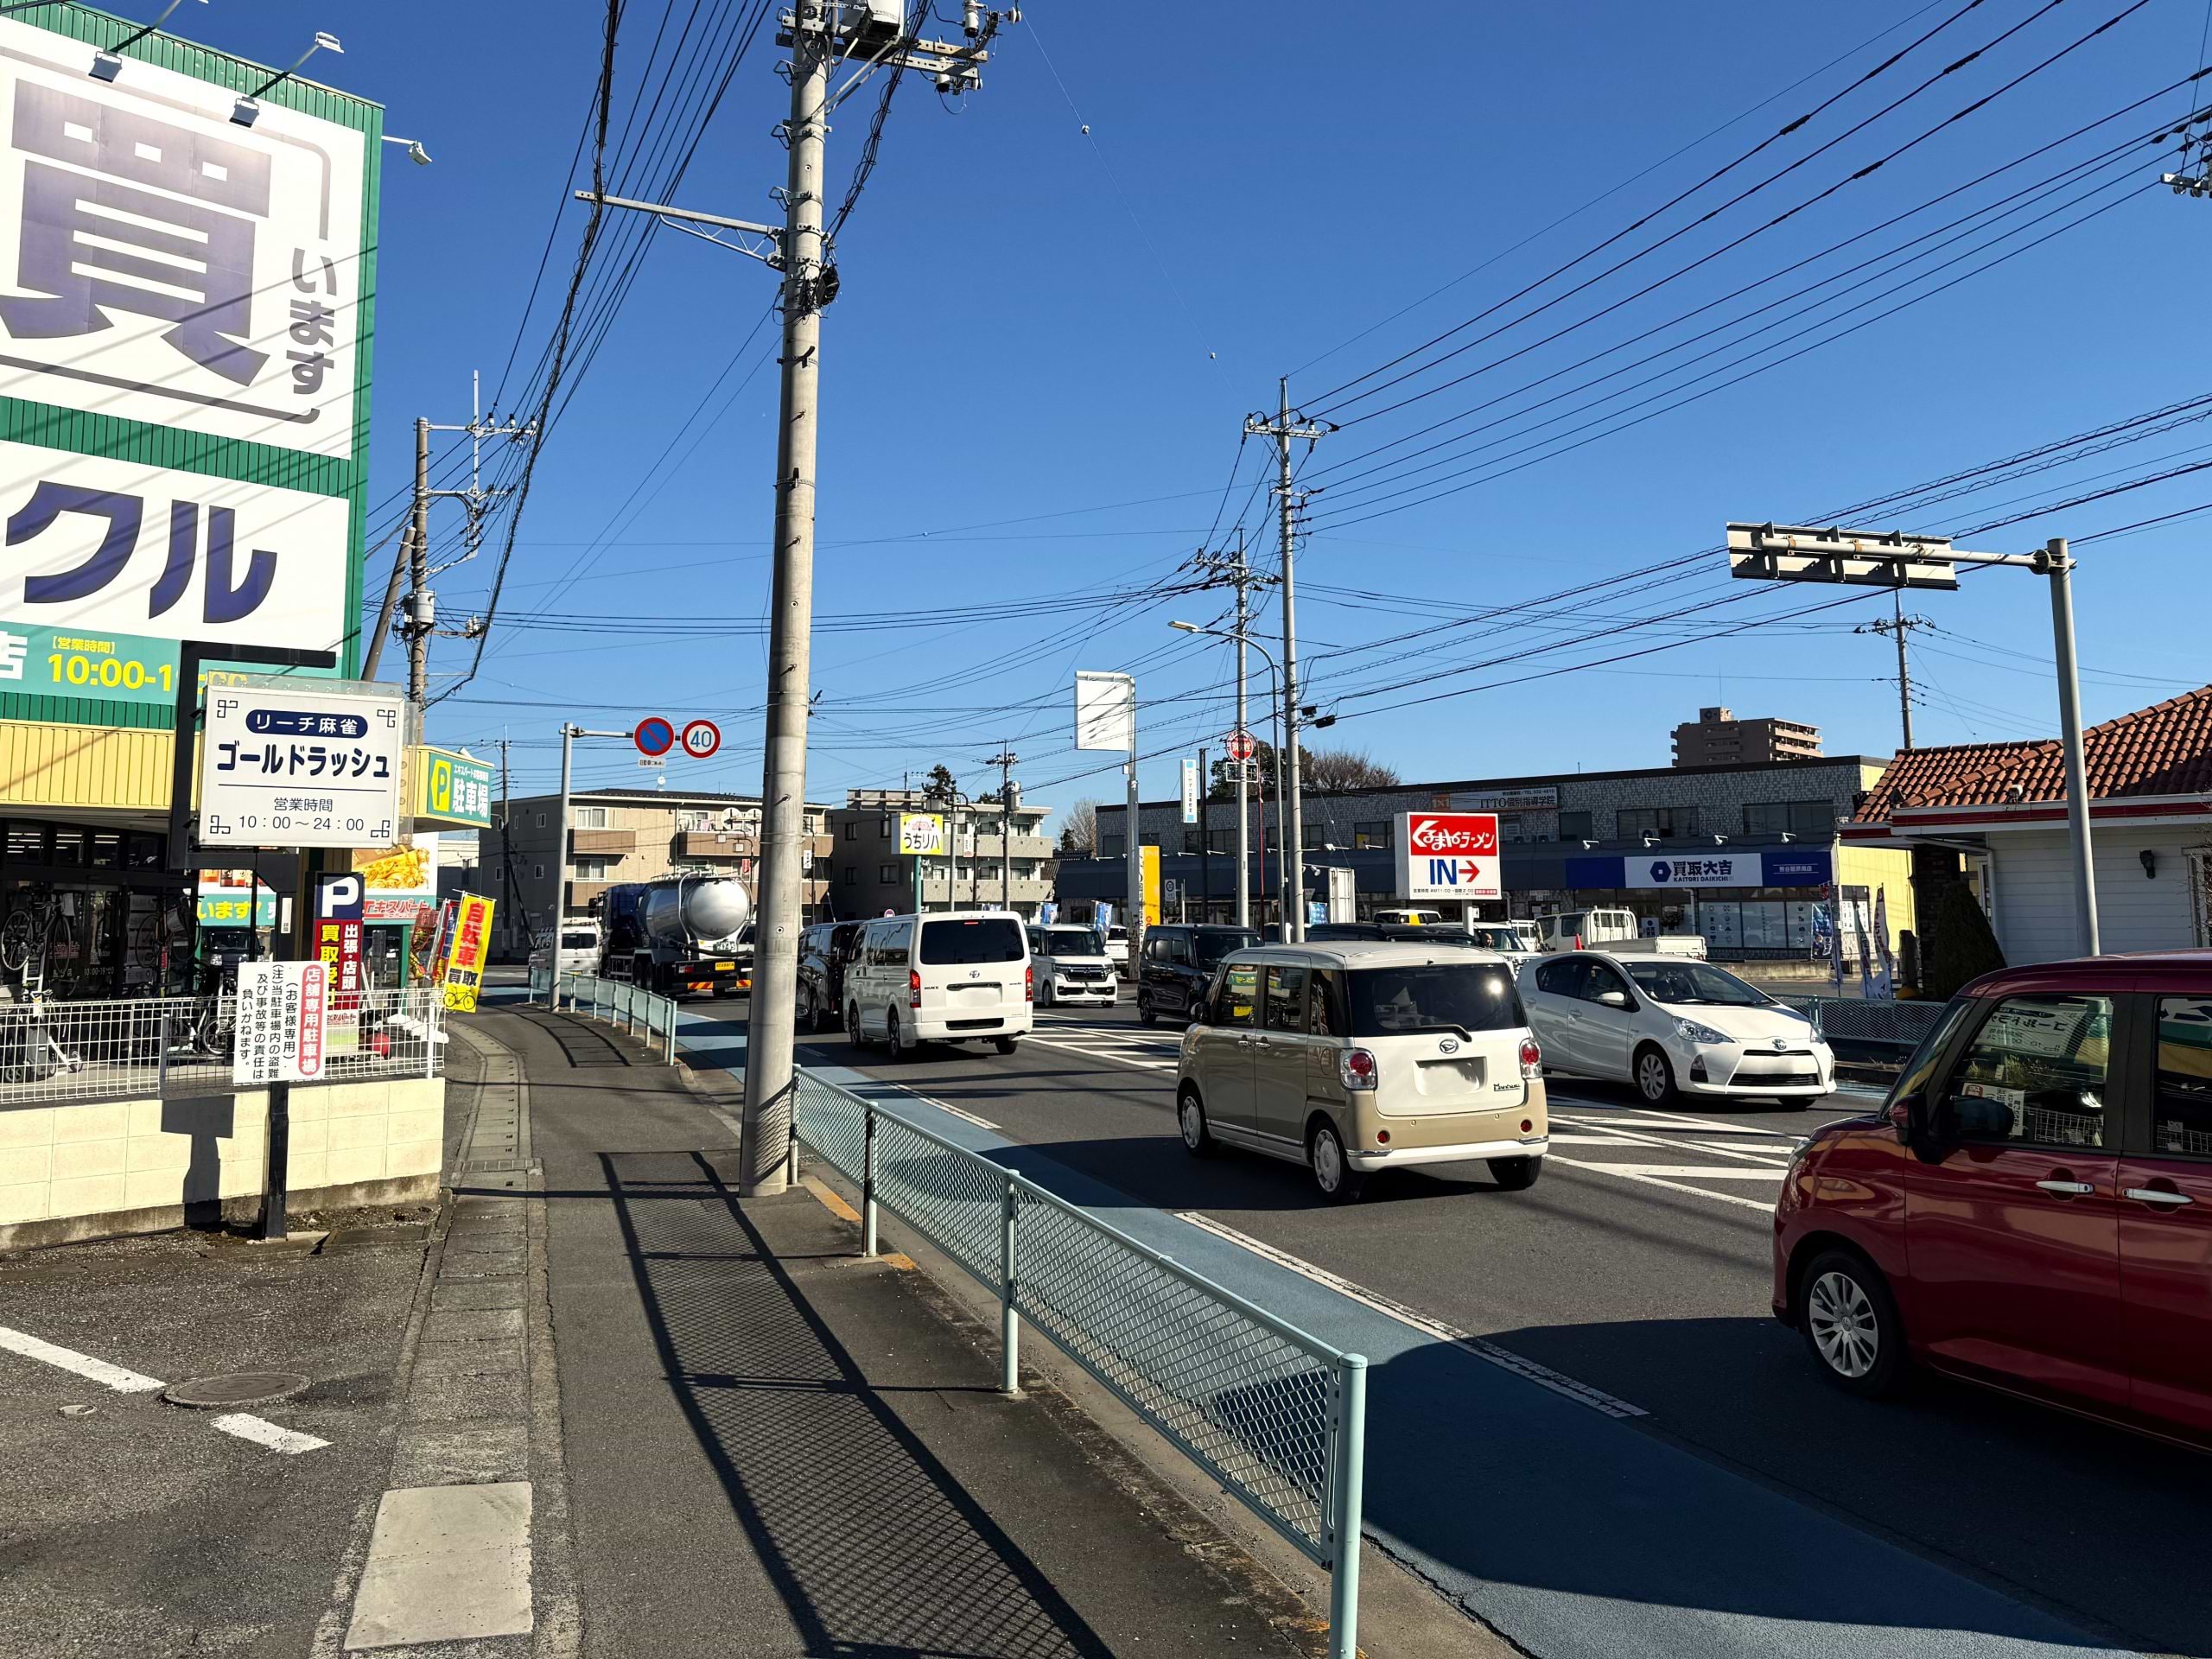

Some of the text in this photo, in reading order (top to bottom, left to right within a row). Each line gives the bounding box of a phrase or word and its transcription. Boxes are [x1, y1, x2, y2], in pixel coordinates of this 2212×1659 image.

[0, 78, 271, 387] 買
[286, 247, 337, 395] います
[6, 480, 277, 624] クル
[256, 714, 358, 735] リーチ麻雀
[690, 730, 712, 747] 40
[217, 740, 390, 778] ゴールドラッシュ
[273, 797, 333, 812] 営業時間
[452, 776, 489, 818] 駐車場
[1480, 795, 1555, 809] ITTO個別指導学院
[904, 832, 940, 850] うちリハ
[1412, 820, 1495, 851] くるまやラーメン
[1429, 859, 1458, 886] IN
[1672, 859, 1733, 875] 買取大吉
[321, 876, 359, 918] P
[455, 902, 486, 967] 自転車
[342, 924, 359, 990] 出張・店頭
[448, 968, 479, 987] 買取
[239, 988, 253, 1066] 負いかねます。
[252, 974, 268, 1079] 及び事故等の責任は
[267, 964, 284, 1079] (注)当駐車場内の盗難
[283, 982, 298, 1059] (お客様専用)
[302, 967, 321, 1073] 店舗専用駐車場
